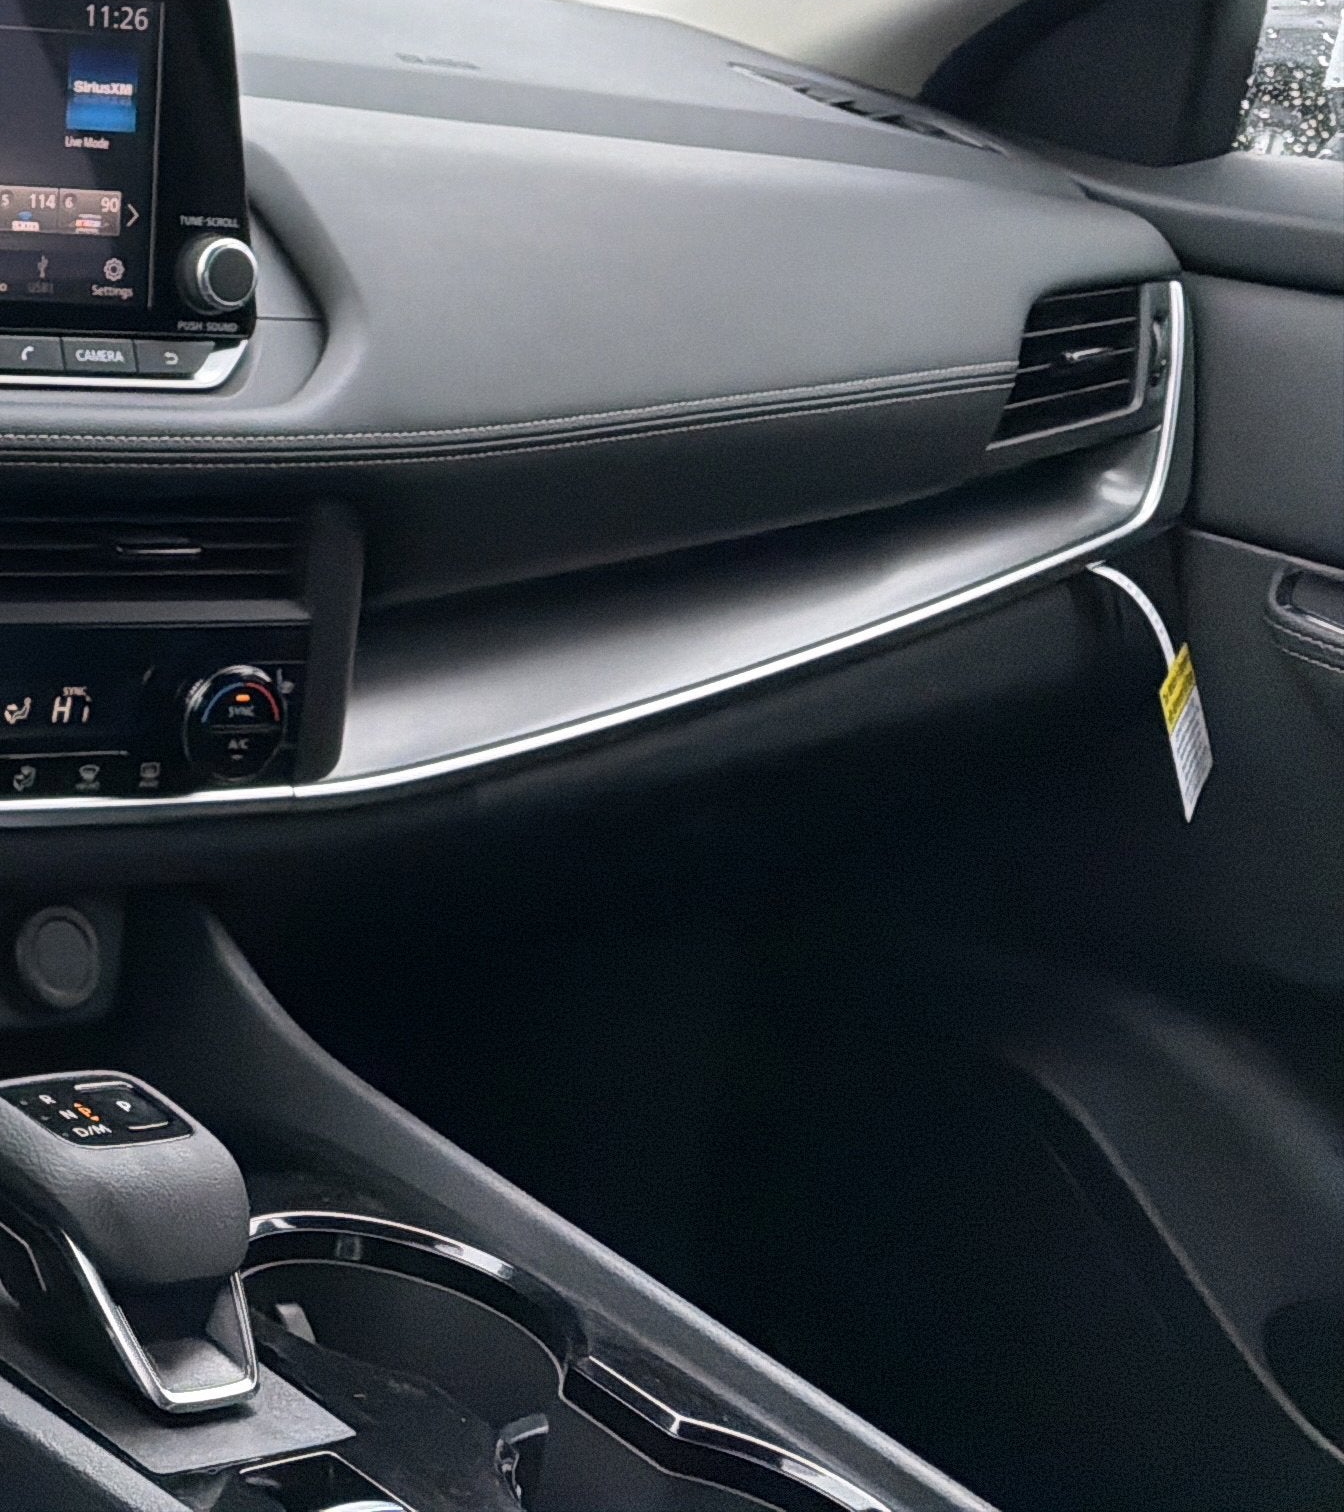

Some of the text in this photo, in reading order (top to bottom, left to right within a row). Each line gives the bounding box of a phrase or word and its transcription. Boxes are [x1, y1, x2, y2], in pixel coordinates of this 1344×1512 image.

[86, 3, 150, 31] 11:26
[1, 195, 10, 207] 5
[29, 193, 57, 209] 114
[64, 196, 75, 209] 6
[100, 196, 120, 213] 90
[91, 284, 134, 300] Settings
[75, 348, 125, 364] CAMERA
[228, 706, 255, 718] SYNC
[38, 1094, 57, 1105] R
[115, 1100, 132, 1113] P
[58, 1109, 79, 1120] N
[72, 1123, 113, 1138] D/M
